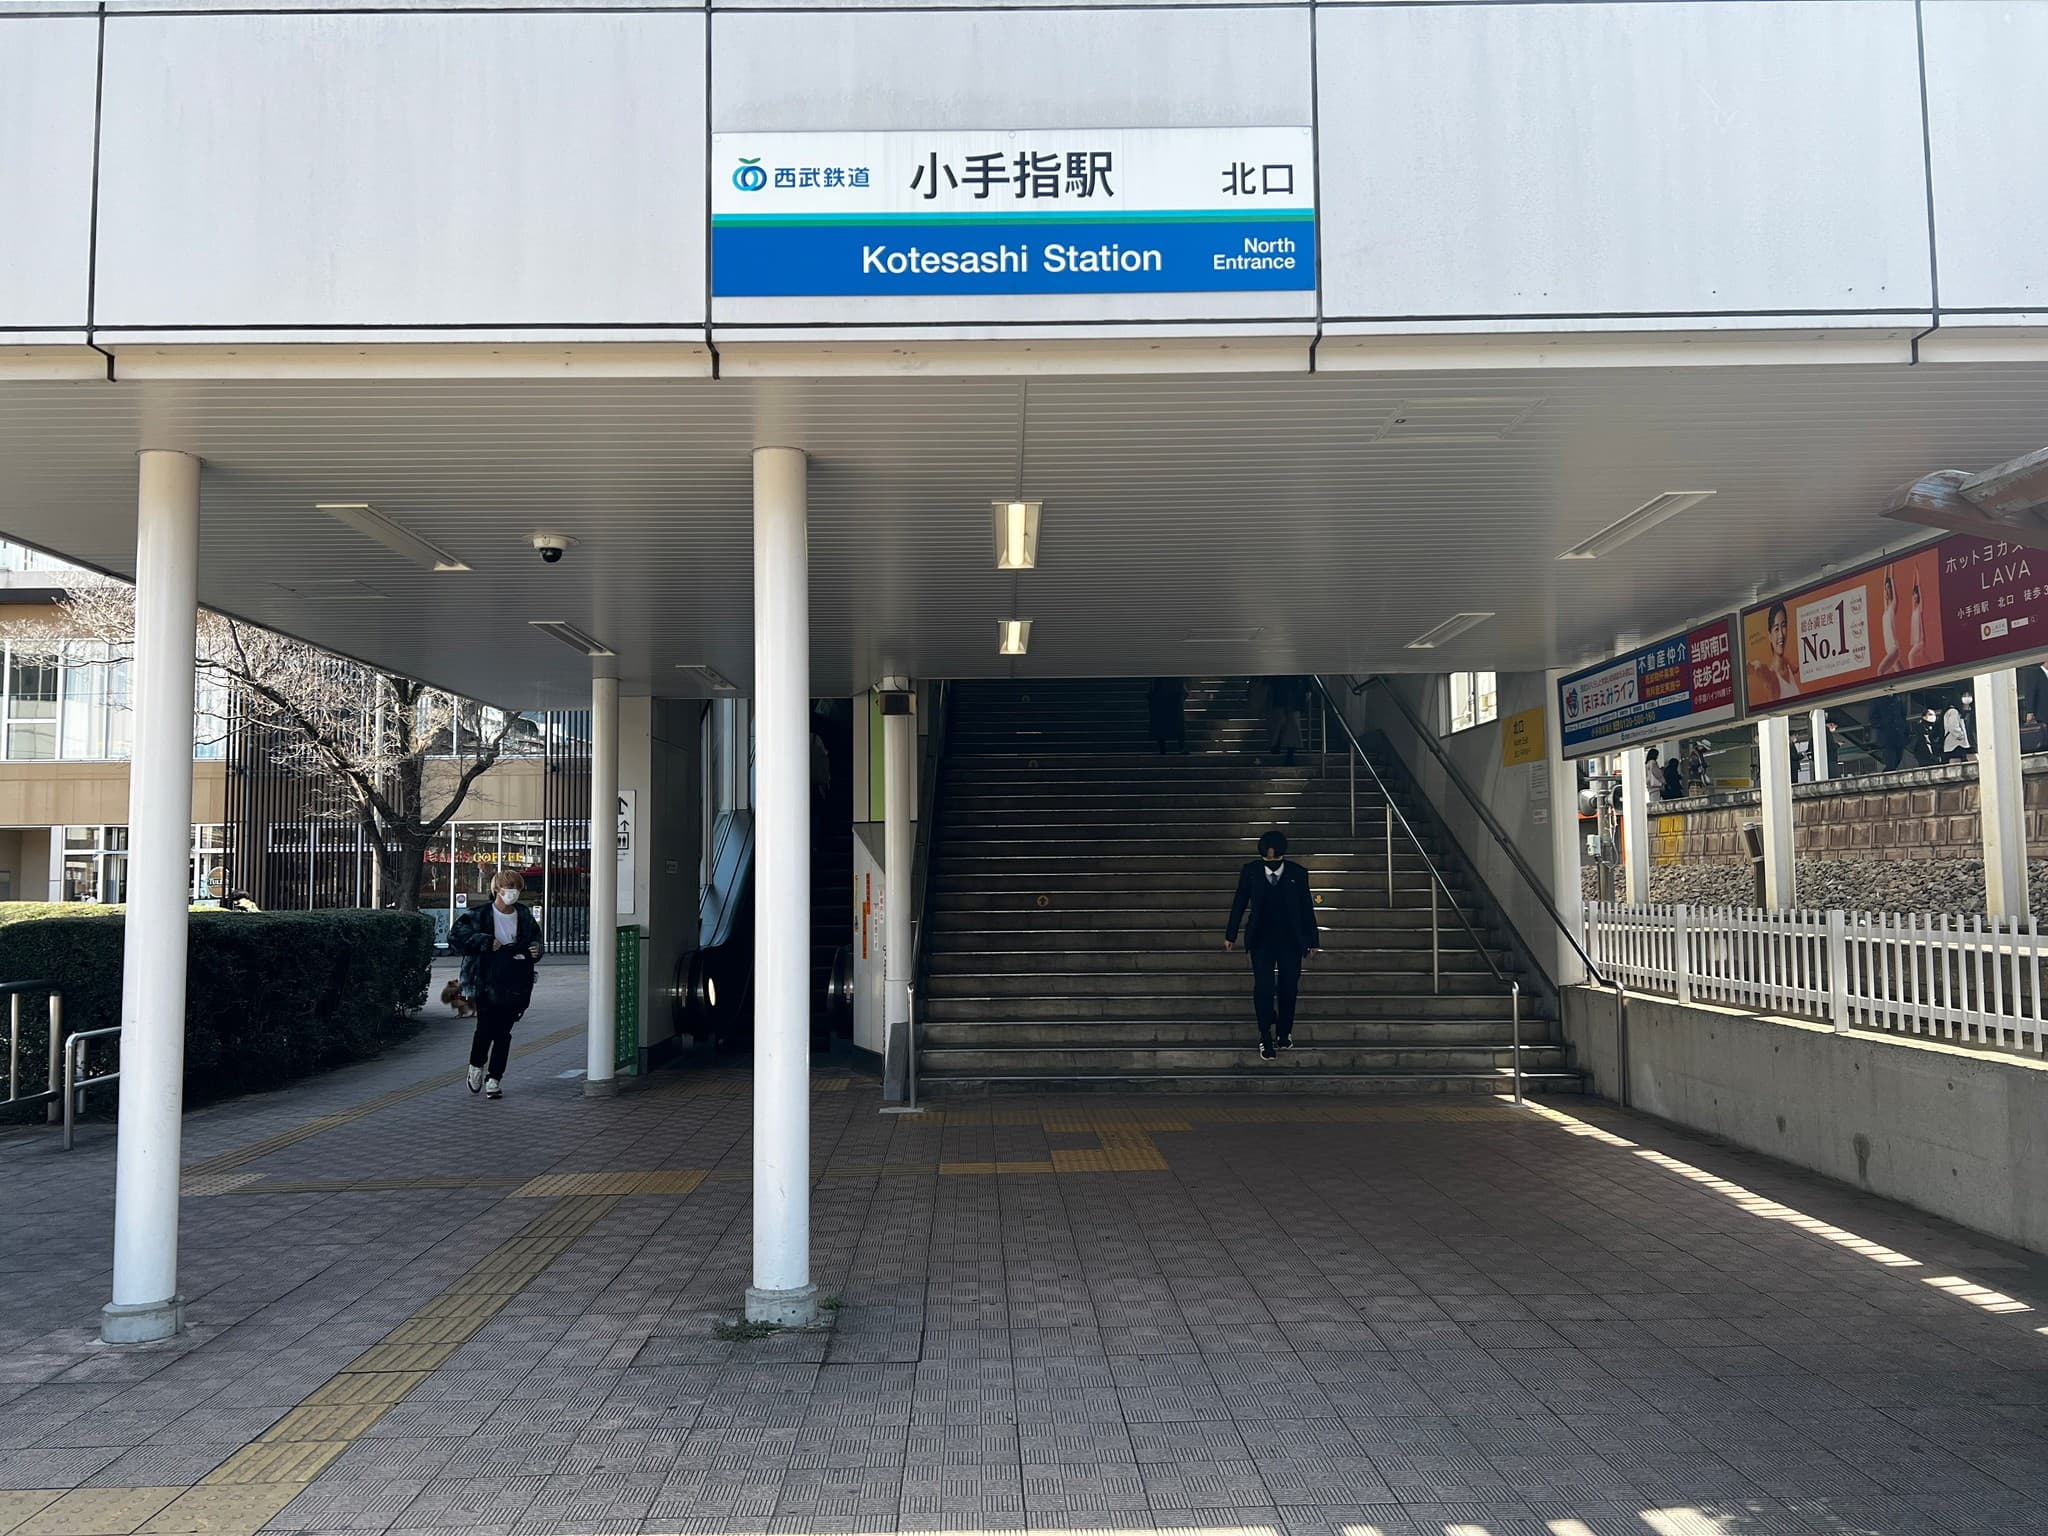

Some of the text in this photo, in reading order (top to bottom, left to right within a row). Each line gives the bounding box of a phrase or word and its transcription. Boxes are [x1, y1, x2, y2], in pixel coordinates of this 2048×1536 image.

[774, 166, 870, 188] 西武鉄道
[910, 151, 1114, 199] 小手指駅
[1221, 161, 1295, 196] 北口
[863, 243, 1162, 274] Kotesashi Station
[1244, 237, 1295, 254] North
[1213, 253, 1295, 270] Entrance
[1981, 559, 2031, 590] LAVA
[1957, 600, 1990, 619] 小手指駅
[1997, 594, 2014, 608] 北口
[1801, 612, 1834, 633] 総合満足度
[1801, 600, 1849, 664] No.1
[1637, 643, 1686, 673] 不動産仲介
[1691, 633, 1729, 663] 当駅南口
[1692, 659, 1731, 689] 徒歩2分
[1581, 679, 1635, 714] ほほえみライフ
